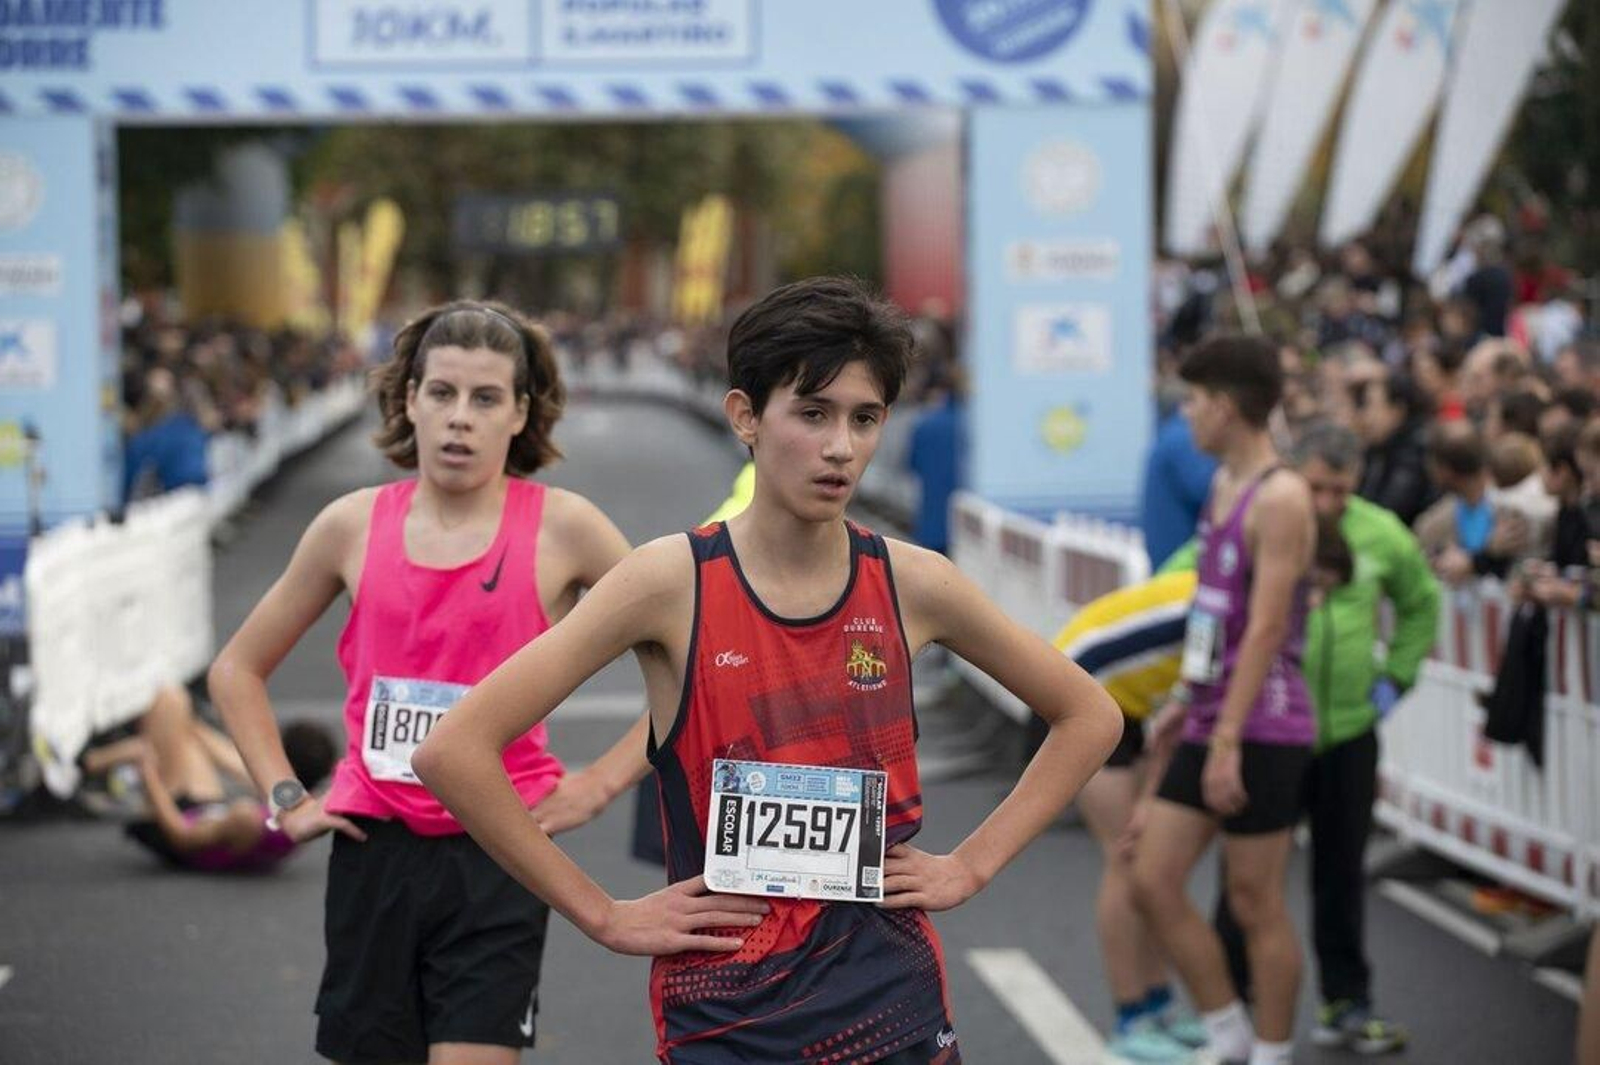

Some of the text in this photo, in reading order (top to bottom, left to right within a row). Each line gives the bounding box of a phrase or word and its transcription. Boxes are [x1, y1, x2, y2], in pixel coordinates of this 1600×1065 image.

[843, 624, 884, 634] OURENSE
[852, 616, 877, 626] CLUB
[393, 708, 444, 744] 80
[721, 799, 737, 854] ESCOLAR
[745, 800, 857, 853] 12597
